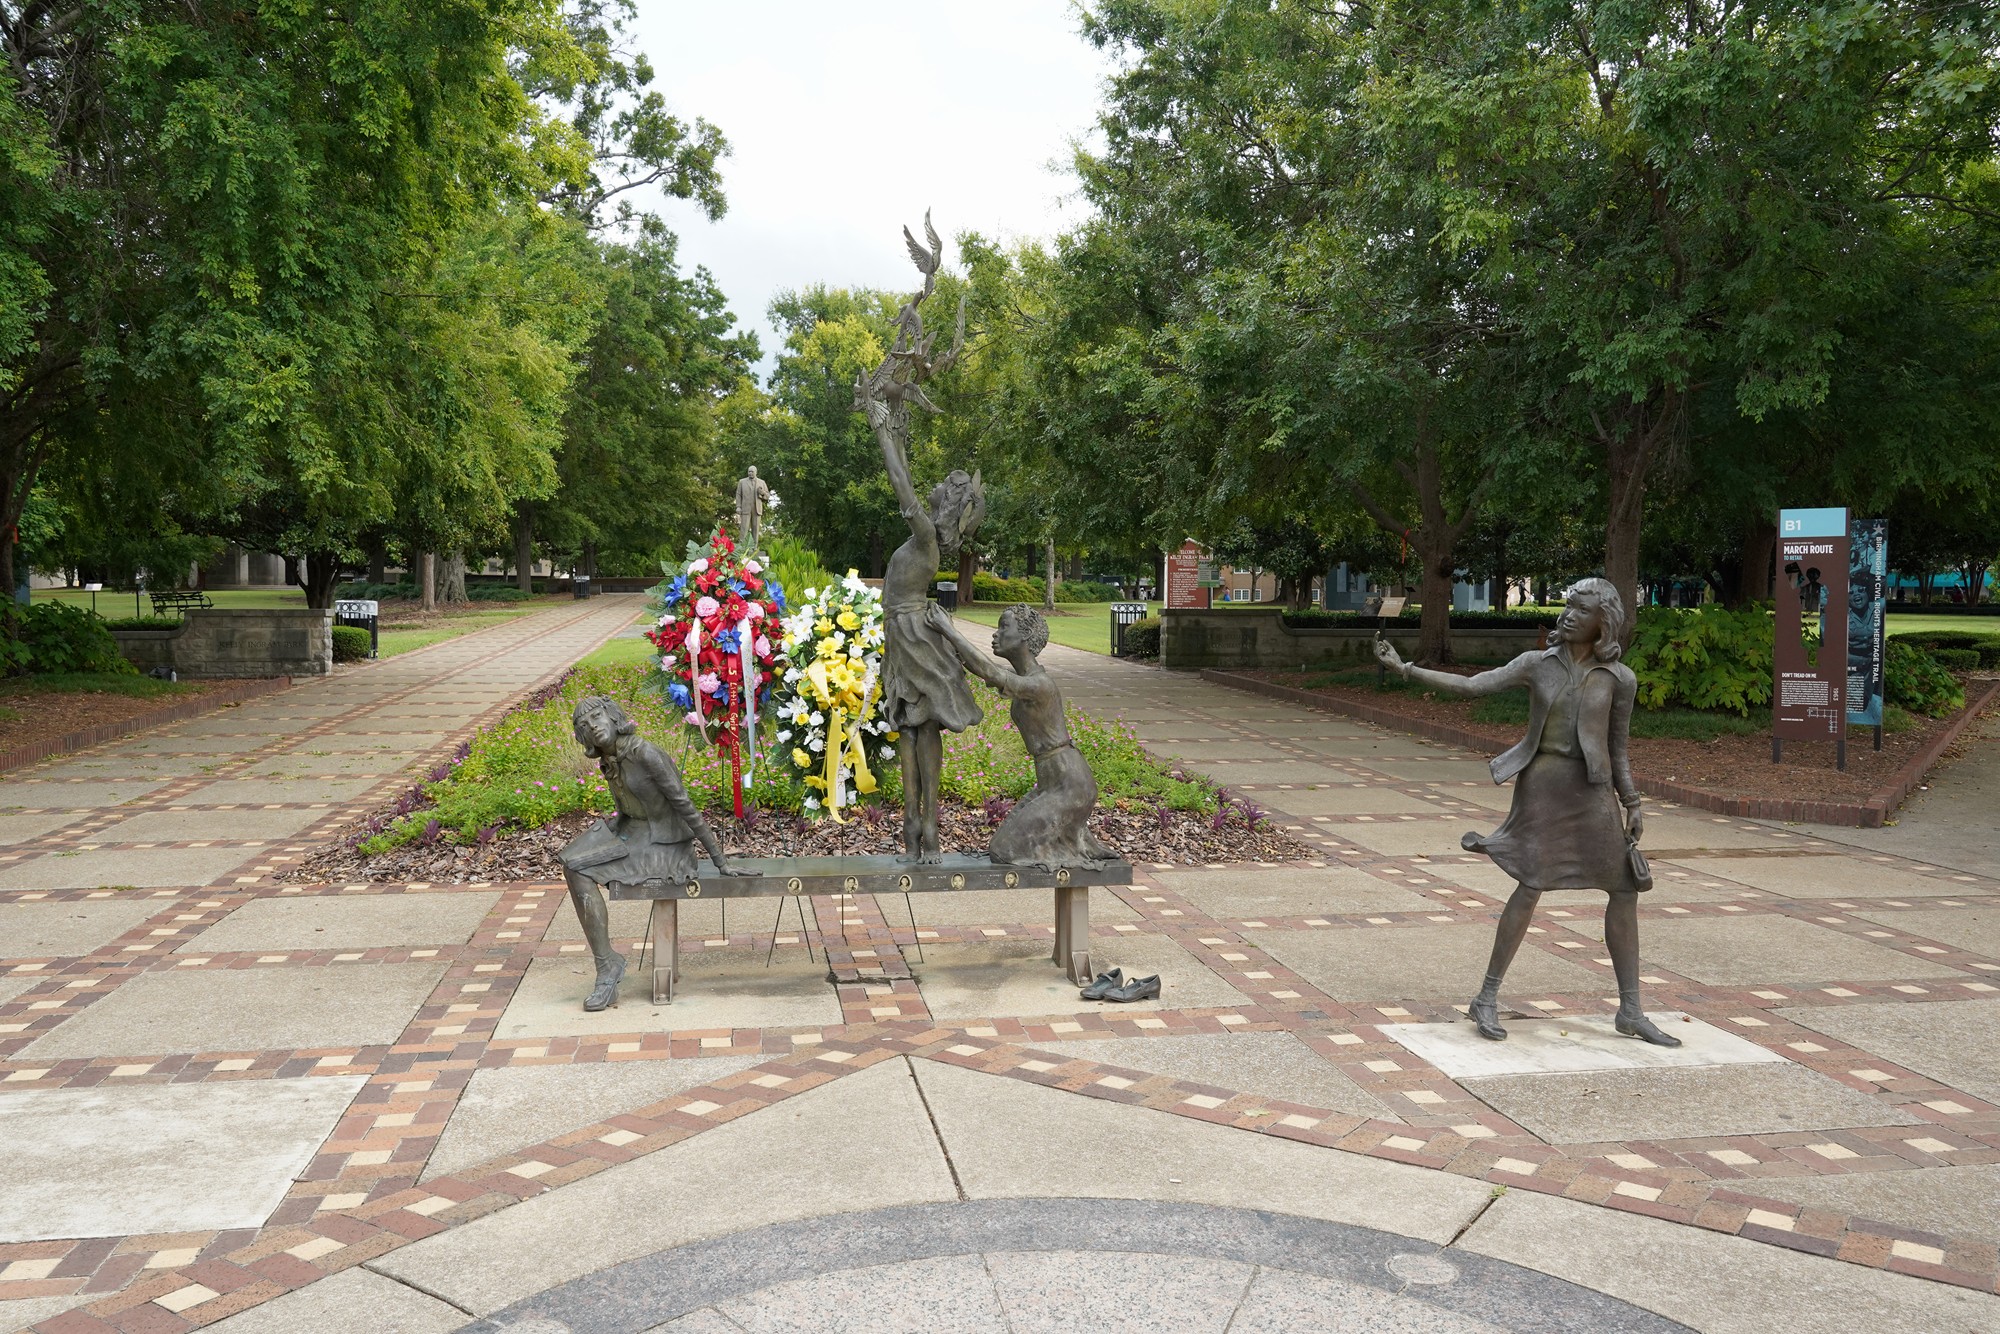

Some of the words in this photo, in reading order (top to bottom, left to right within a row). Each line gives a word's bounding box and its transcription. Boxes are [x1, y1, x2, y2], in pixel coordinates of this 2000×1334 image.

[1785, 520, 1801, 531] B1
[1784, 545, 1808, 555] MARCH
[1810, 545, 1833, 554] ROUTE
[1874, 536, 1883, 581] BIRMINGHAM
[248, 640, 280, 648] INGRAM
[728, 667, 737, 676] 5
